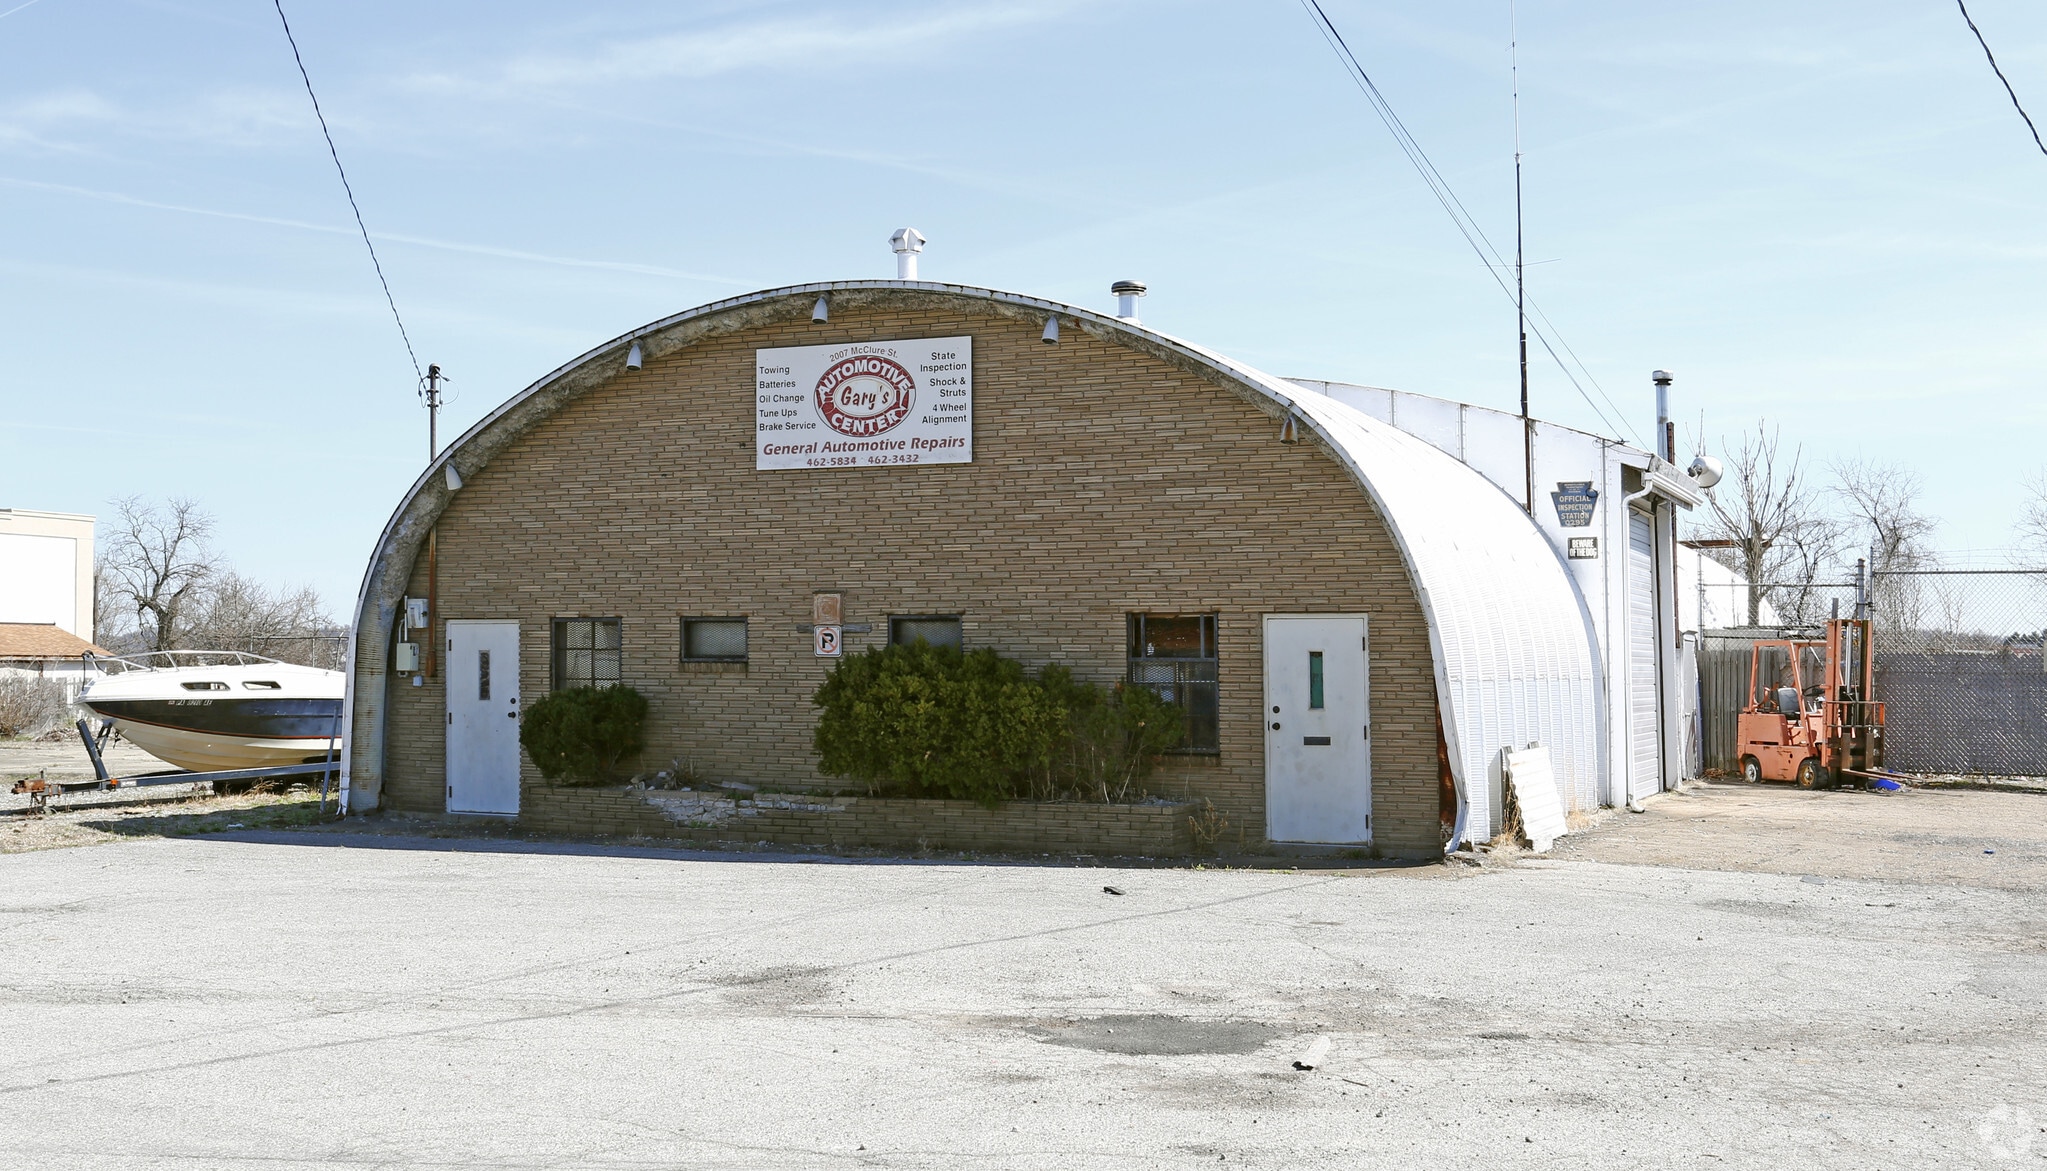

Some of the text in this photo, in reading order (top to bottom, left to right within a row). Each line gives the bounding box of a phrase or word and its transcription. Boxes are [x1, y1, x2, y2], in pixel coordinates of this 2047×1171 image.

[829, 345, 898, 362] 2007 McClure St.
[931, 351, 956, 359] State
[759, 366, 790, 375] Towing
[920, 362, 967, 373] Inspection
[759, 380, 796, 389] Batteries
[819, 359, 911, 401] AUTOMOTIVE
[930, 376, 966, 386] Shock &
[841, 385, 889, 410] Gary's
[940, 389, 967, 397] Struts
[759, 394, 805, 404] Oil Change
[940, 403, 967, 411] Wheel
[759, 409, 798, 418] Tune Ups
[831, 411, 900, 434] CENTER
[922, 415, 967, 426] Alignment
[759, 421, 816, 431] Brake Service
[763, 436, 966, 456] General Automotive Repairs
[806, 454, 919, 467] 462-5834 462-3432
[1572, 539, 1593, 548] BEWARE
